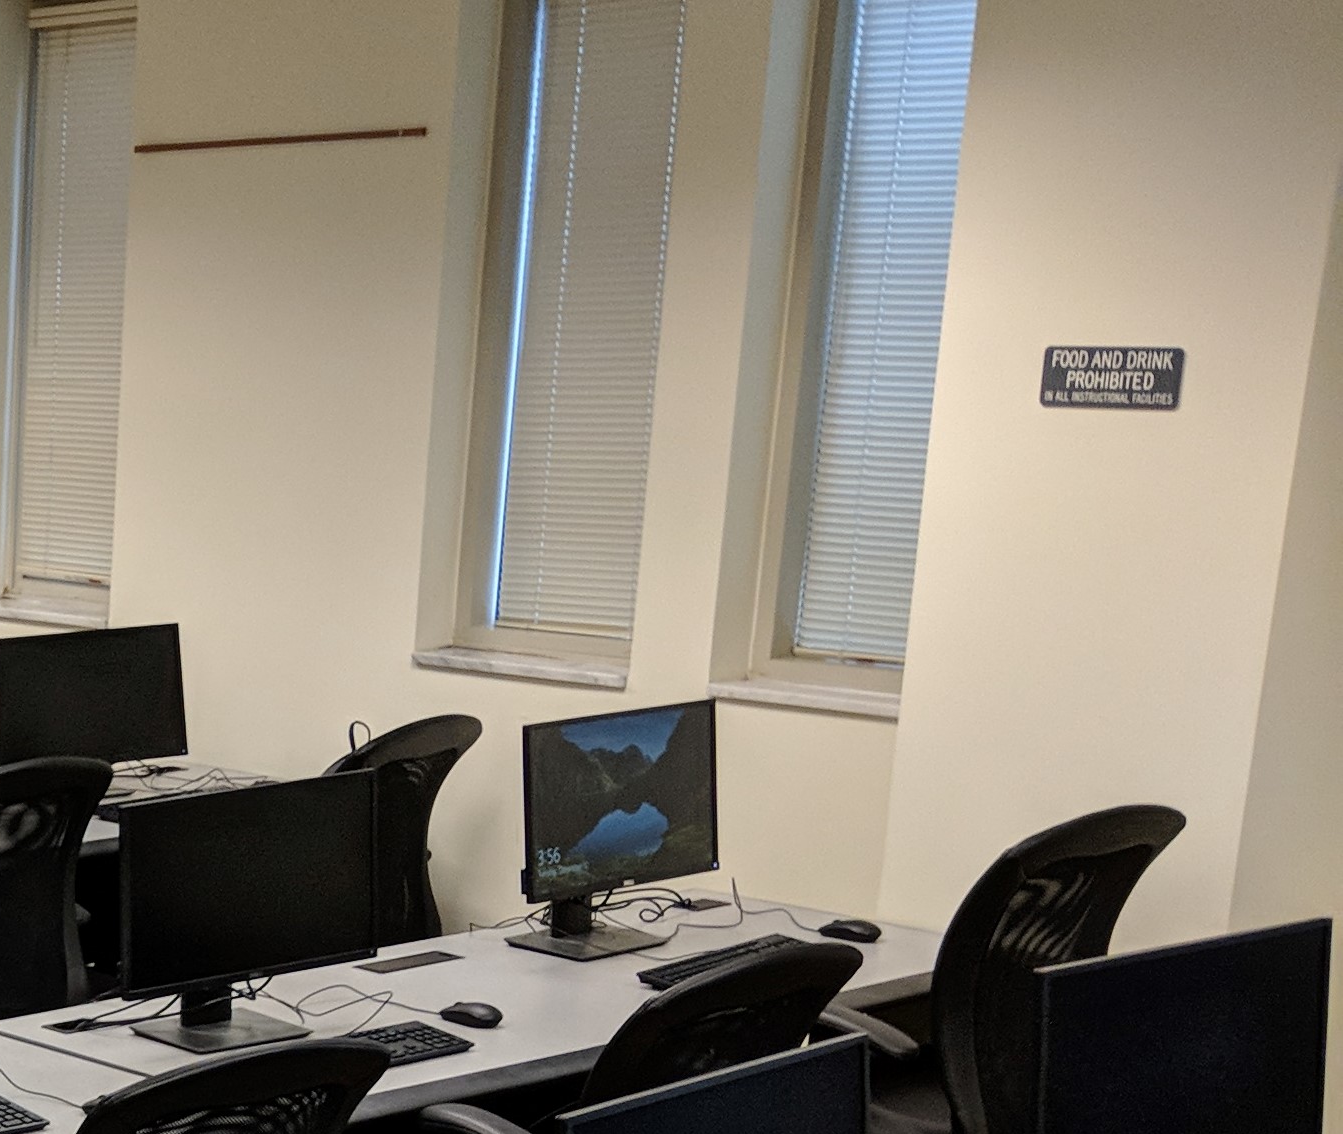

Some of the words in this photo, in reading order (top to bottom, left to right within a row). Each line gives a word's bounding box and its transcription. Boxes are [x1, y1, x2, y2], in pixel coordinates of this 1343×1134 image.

[1051, 349, 1089, 369] FOOD
[1090, 350, 1124, 370] AND
[1126, 351, 1174, 371] DRINK
[1065, 371, 1155, 391] PROHIBITED
[1055, 391, 1070, 403] ALL
[1071, 391, 1130, 404] INSTRUCTIONAL
[1132, 392, 1174, 406] FACILITIES
[537, 846, 562, 867] 3:56
